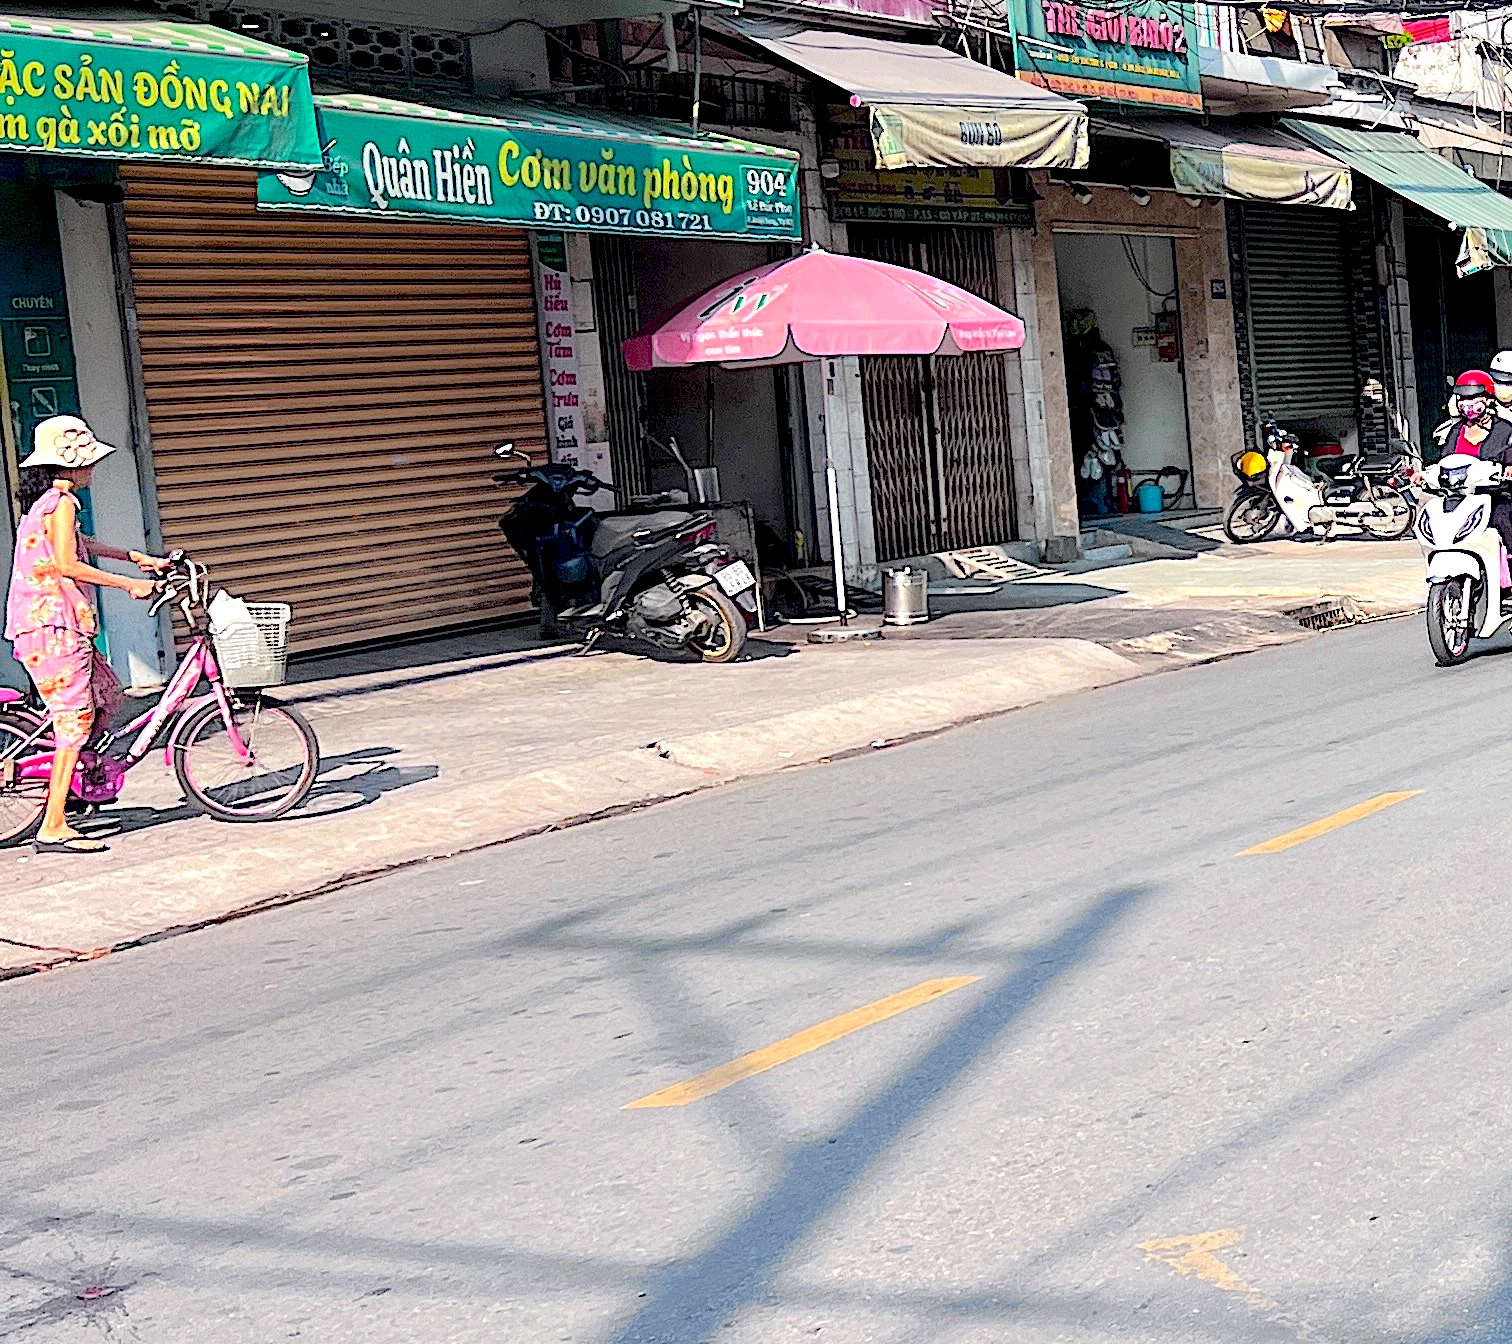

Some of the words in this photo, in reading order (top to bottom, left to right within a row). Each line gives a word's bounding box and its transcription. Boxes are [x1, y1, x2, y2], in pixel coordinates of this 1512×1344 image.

[53, 54, 124, 105] SẢN
[132, 59, 234, 119] ĐỒNG
[236, 80, 290, 118] NAI
[36, 104, 81, 151] gà
[87, 106, 141, 149] xối
[147, 118, 201, 151] mỡ
[362, 136, 433, 211] Quân
[432, 136, 494, 206] Hiền
[498, 139, 573, 192] Cơm
[577, 147, 638, 198] văn
[642, 154, 735, 215] phòng
[746, 168, 788, 197] 904
[533, 201, 572, 223] ĐT:
[575, 204, 635, 226] 0907
[635, 207, 674, 229] 081
[677, 211, 713, 231] 721
